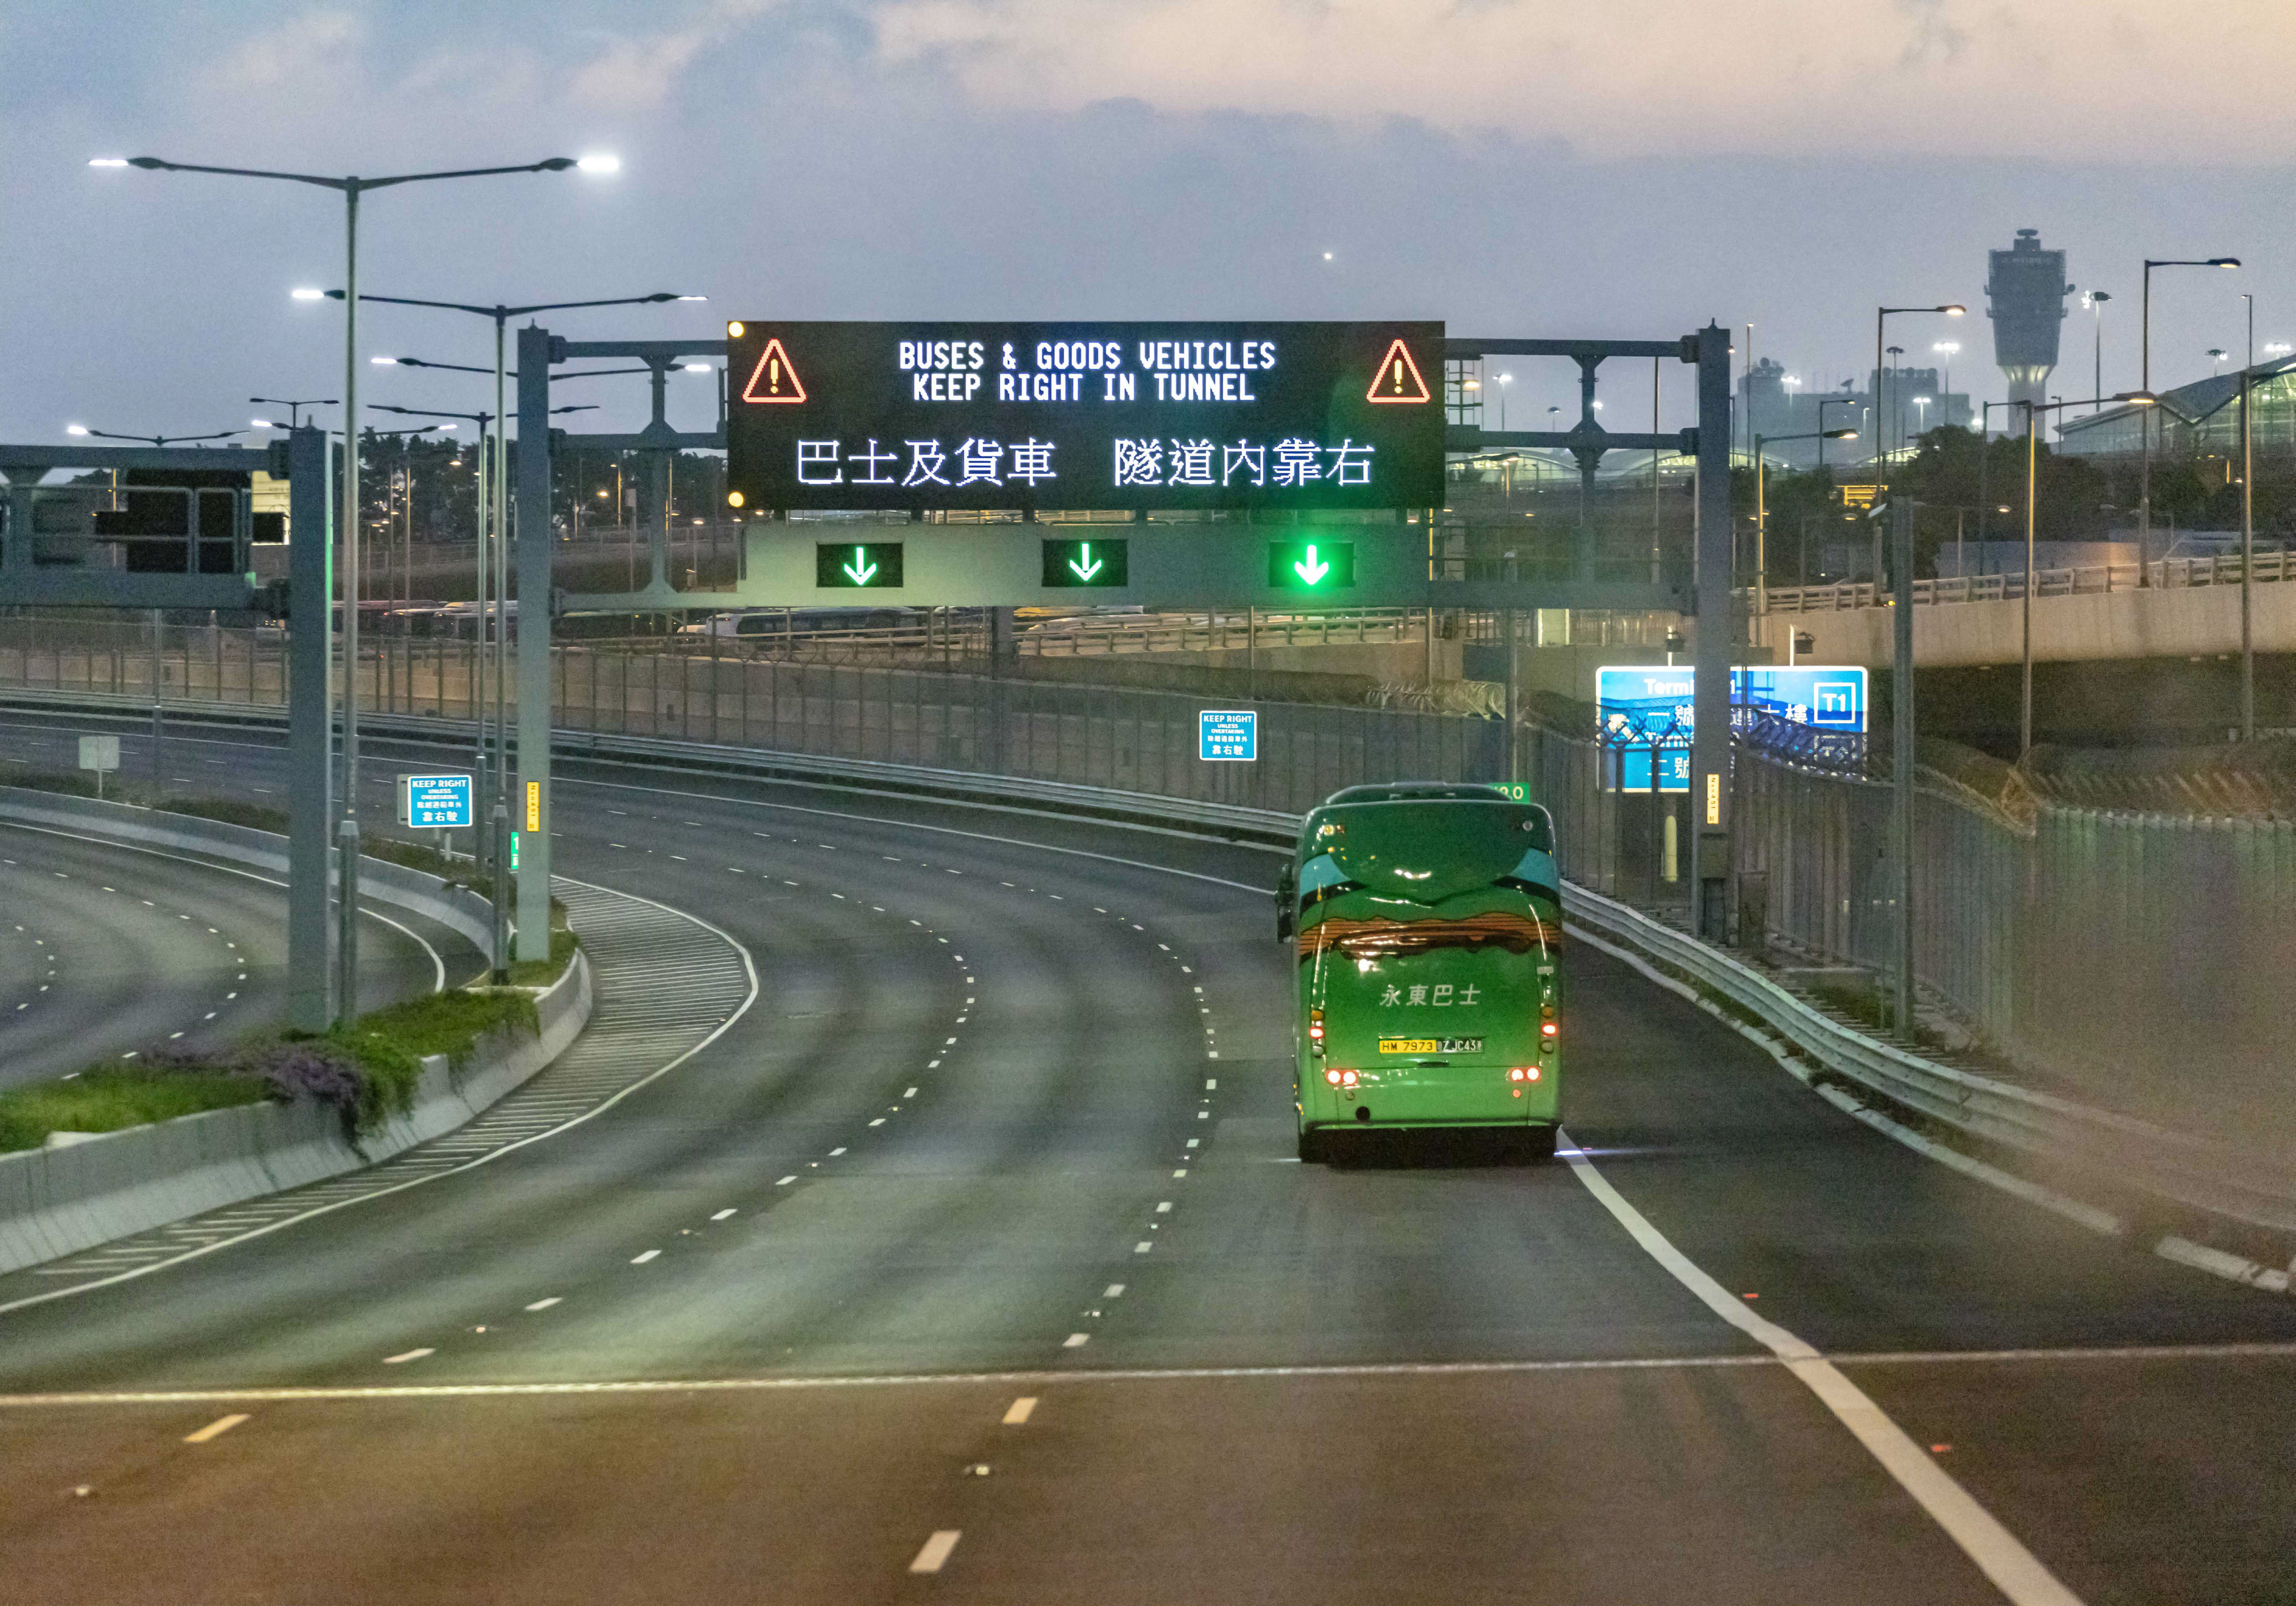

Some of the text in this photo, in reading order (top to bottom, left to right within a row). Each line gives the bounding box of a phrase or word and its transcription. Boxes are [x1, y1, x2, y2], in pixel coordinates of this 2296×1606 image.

[899, 341, 1276, 370] BUSES & GOODS VEHICLES
[913, 373, 1255, 401] KEEP RIGHT IN TUNNEL
[797, 437, 1375, 487] 巴士及貨車 隧道內靠右
[1822, 693, 1846, 712] T1
[1379, 983, 1481, 1007] 永東巴士
[1382, 1042, 1433, 1051] HM 7973
